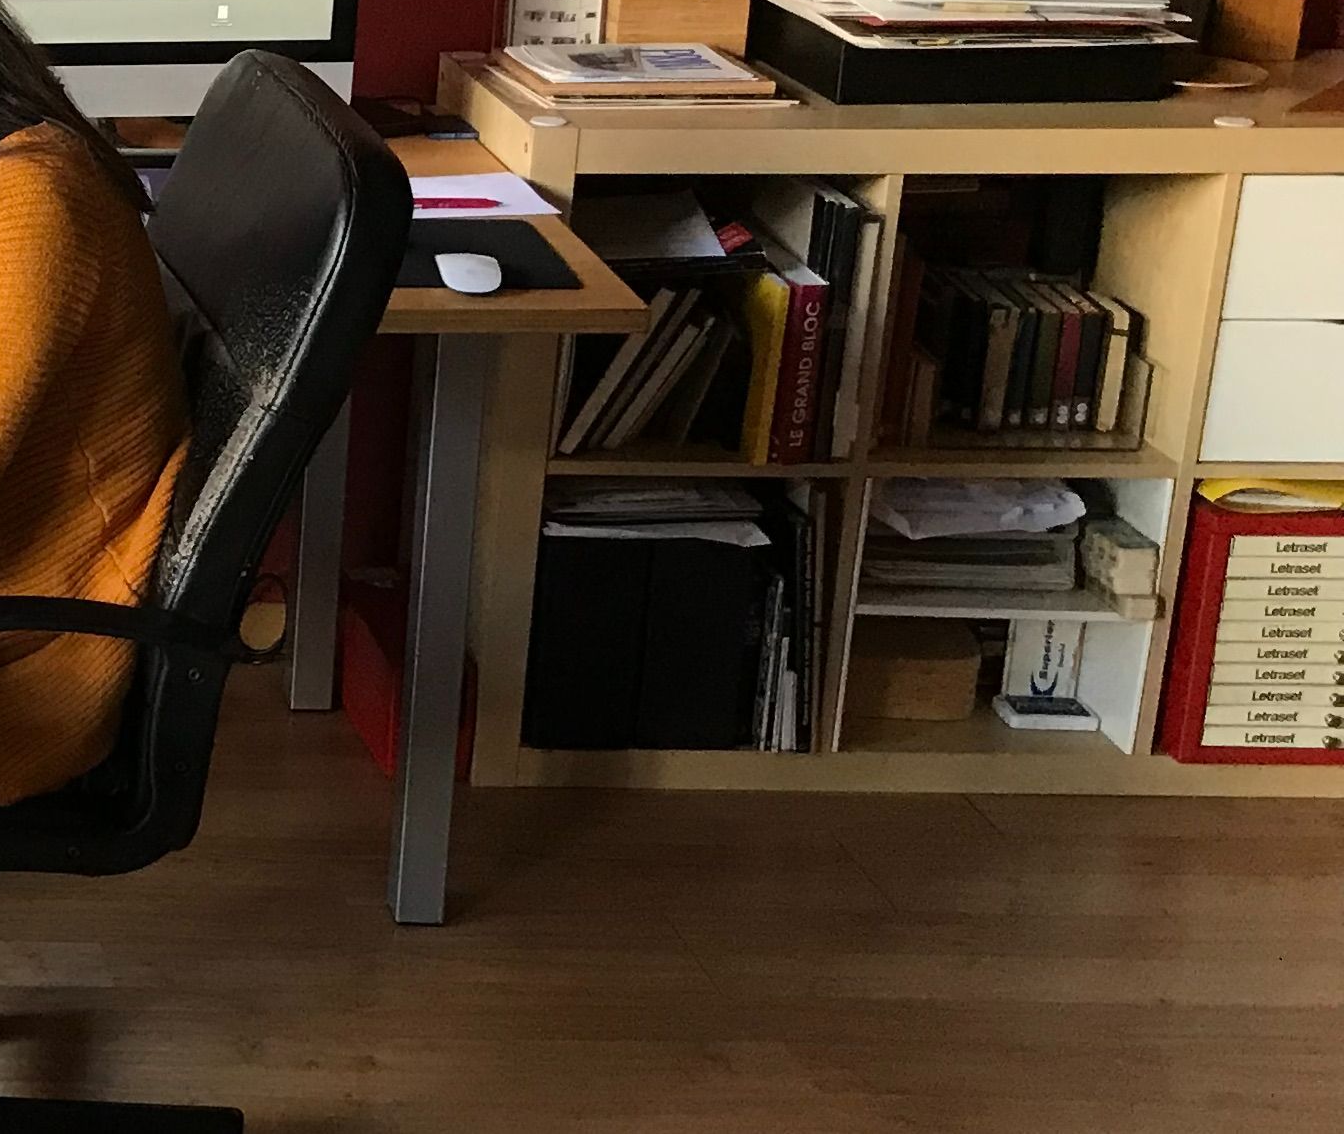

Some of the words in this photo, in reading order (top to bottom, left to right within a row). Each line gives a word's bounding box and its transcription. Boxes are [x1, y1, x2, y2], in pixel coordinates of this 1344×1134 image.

[801, 300, 822, 352] BLOC
[791, 352, 815, 423] GRAND
[789, 424, 805, 448] LE
[1276, 541, 1328, 554] Letraset
[1270, 562, 1322, 575] Letraset
[1267, 585, 1320, 597] Letraset
[1264, 605, 1317, 617] Letraset
[1261, 626, 1313, 639] Letraset
[1257, 648, 1309, 660] Letraset
[1255, 668, 1306, 681] Letraset
[1251, 690, 1303, 702] Letraset
[1247, 710, 1299, 723] Letraset
[1244, 732, 1296, 745] Letraset
